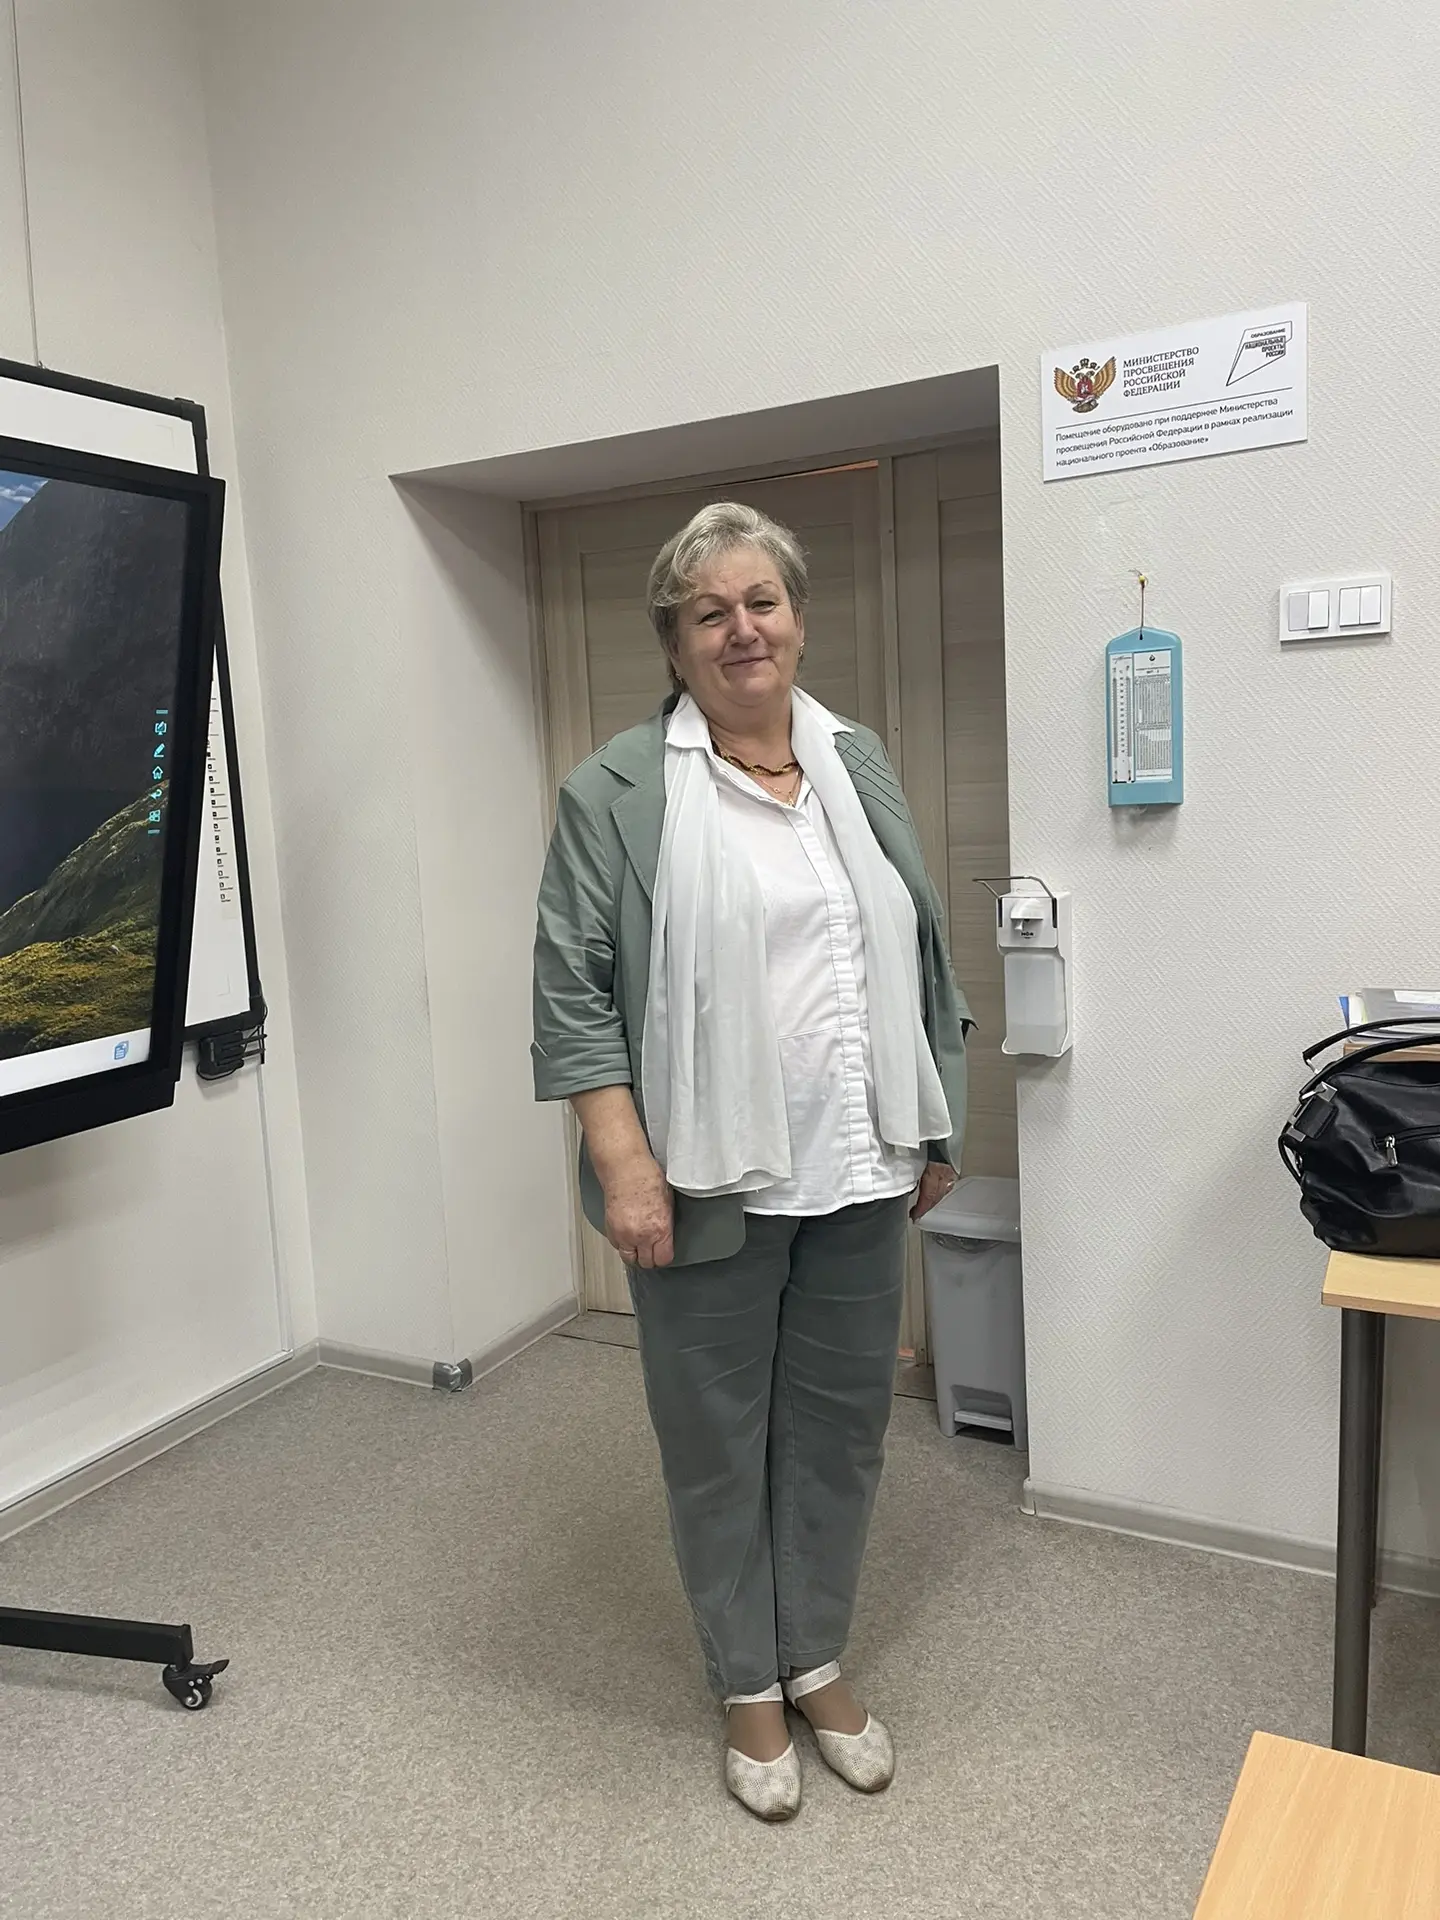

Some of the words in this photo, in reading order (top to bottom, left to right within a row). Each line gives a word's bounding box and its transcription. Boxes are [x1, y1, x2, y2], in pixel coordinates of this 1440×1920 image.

[1251, 328, 1286, 338] ОБРАЗОВАНИЕ
[1123, 347, 1199, 368] МИНИСТЕРСТВО
[1123, 357, 1195, 378] ПРОСВЕЩЕНИЯ
[1123, 368, 1186, 388] РОССИЙСКОЙ
[1123, 380, 1181, 397] ФЕДЕРАЦИИ
[1056, 428, 1101, 442] Помещение
[1102, 418, 1153, 434] оборудовано
[1154, 415, 1170, 426] при
[1171, 409, 1218, 422] поддержке
[1219, 398, 1278, 414] Министерства
[1056, 440, 1108, 455] просвещения
[1109, 431, 1155, 446] Российской
[1156, 423, 1203, 437] Федерации
[1204, 422, 1210, 430] в
[1211, 418, 1241, 430] рамках
[1242, 409, 1294, 425] реализации
[1056, 452, 1115, 467] национального
[1115, 446, 1147, 459] проекта
[1148, 437, 1209, 451] «Образование»
